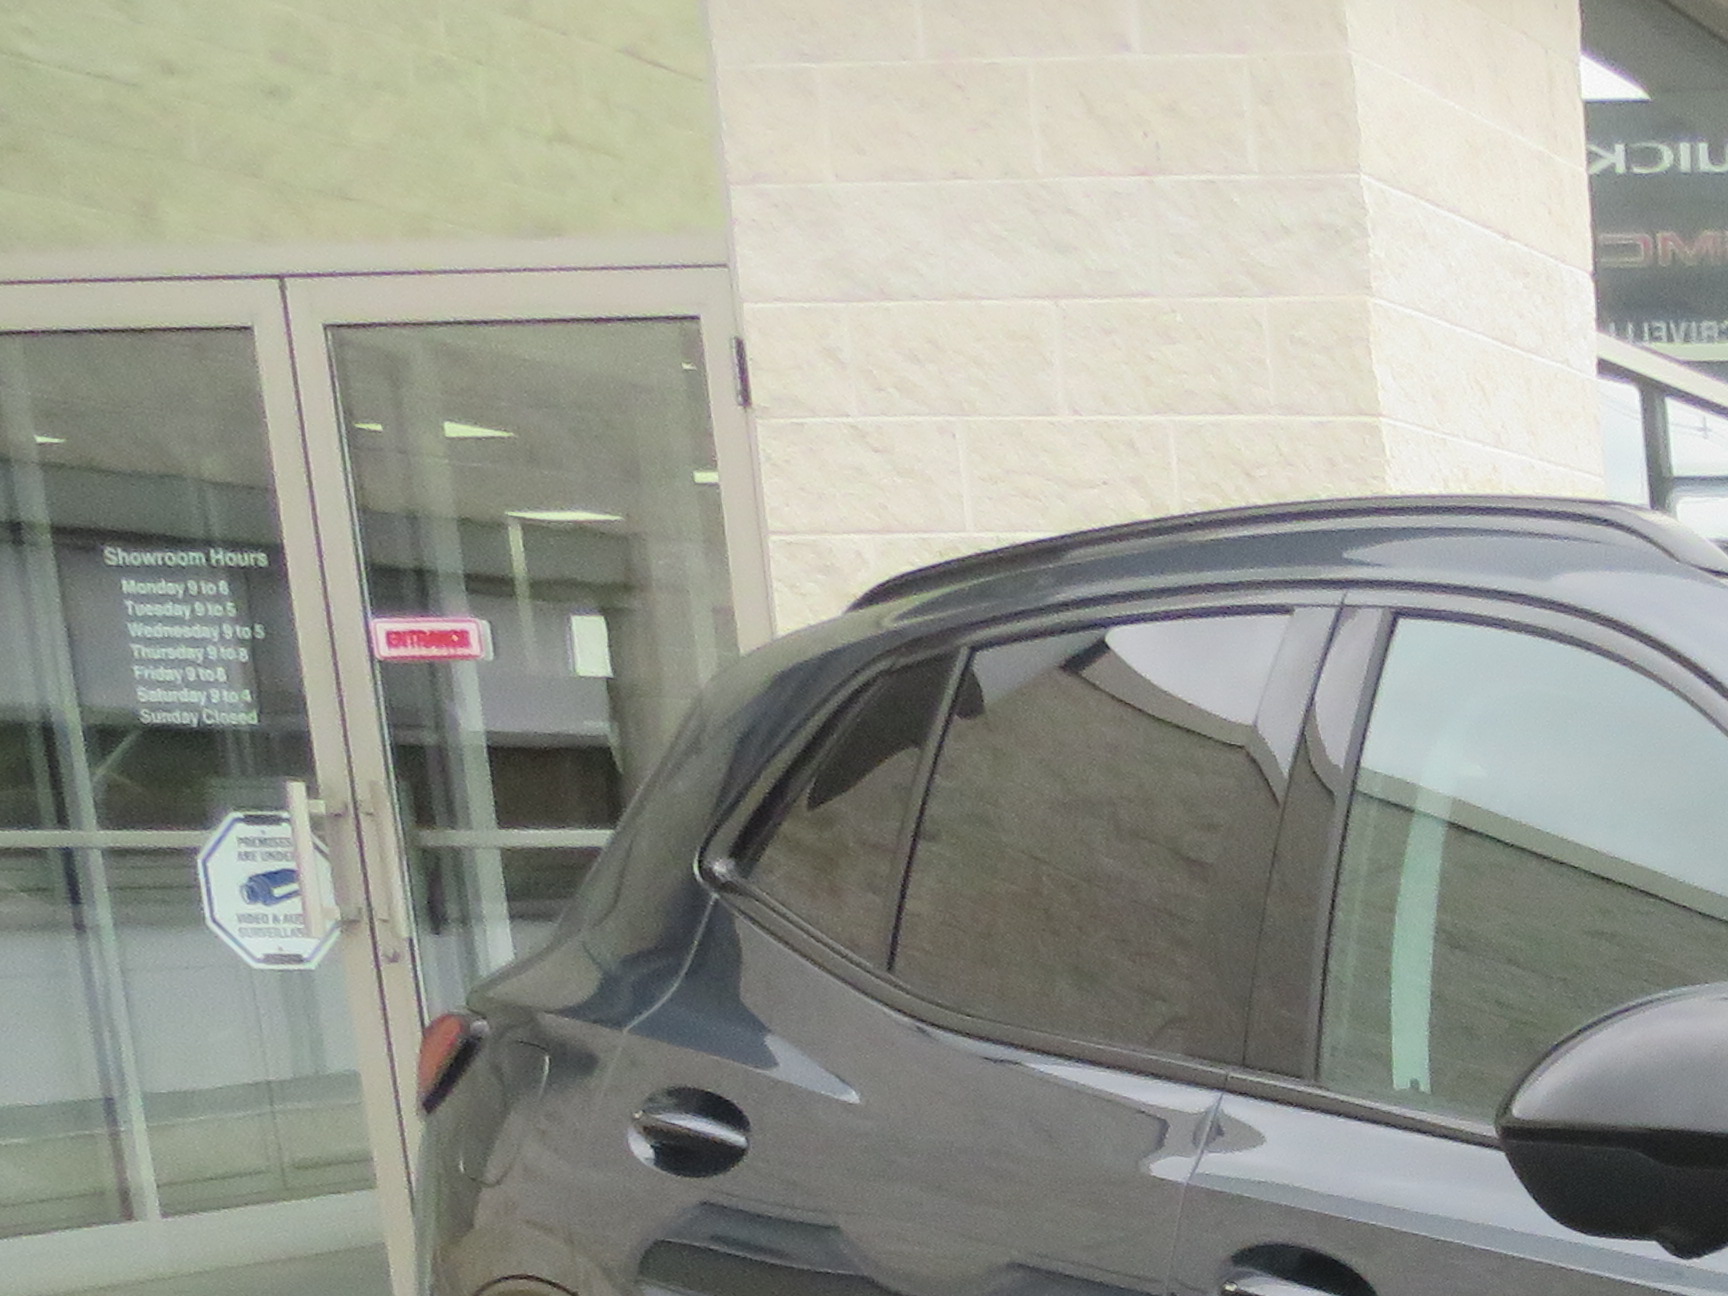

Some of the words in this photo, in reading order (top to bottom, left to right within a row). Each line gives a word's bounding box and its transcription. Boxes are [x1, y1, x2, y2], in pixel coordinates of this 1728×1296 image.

[104, 546, 206, 566] Showroom
[209, 548, 269, 567] Hours
[121, 577, 186, 598] Monday
[123, 600, 192, 620] Tuesday
[126, 621, 220, 642] Wednesday
[129, 643, 204, 664] Thursday
[132, 665, 183, 684] Friday
[136, 685, 207, 706] Saturday
[140, 708, 199, 728] Sunday
[202, 708, 258, 725] Closed
